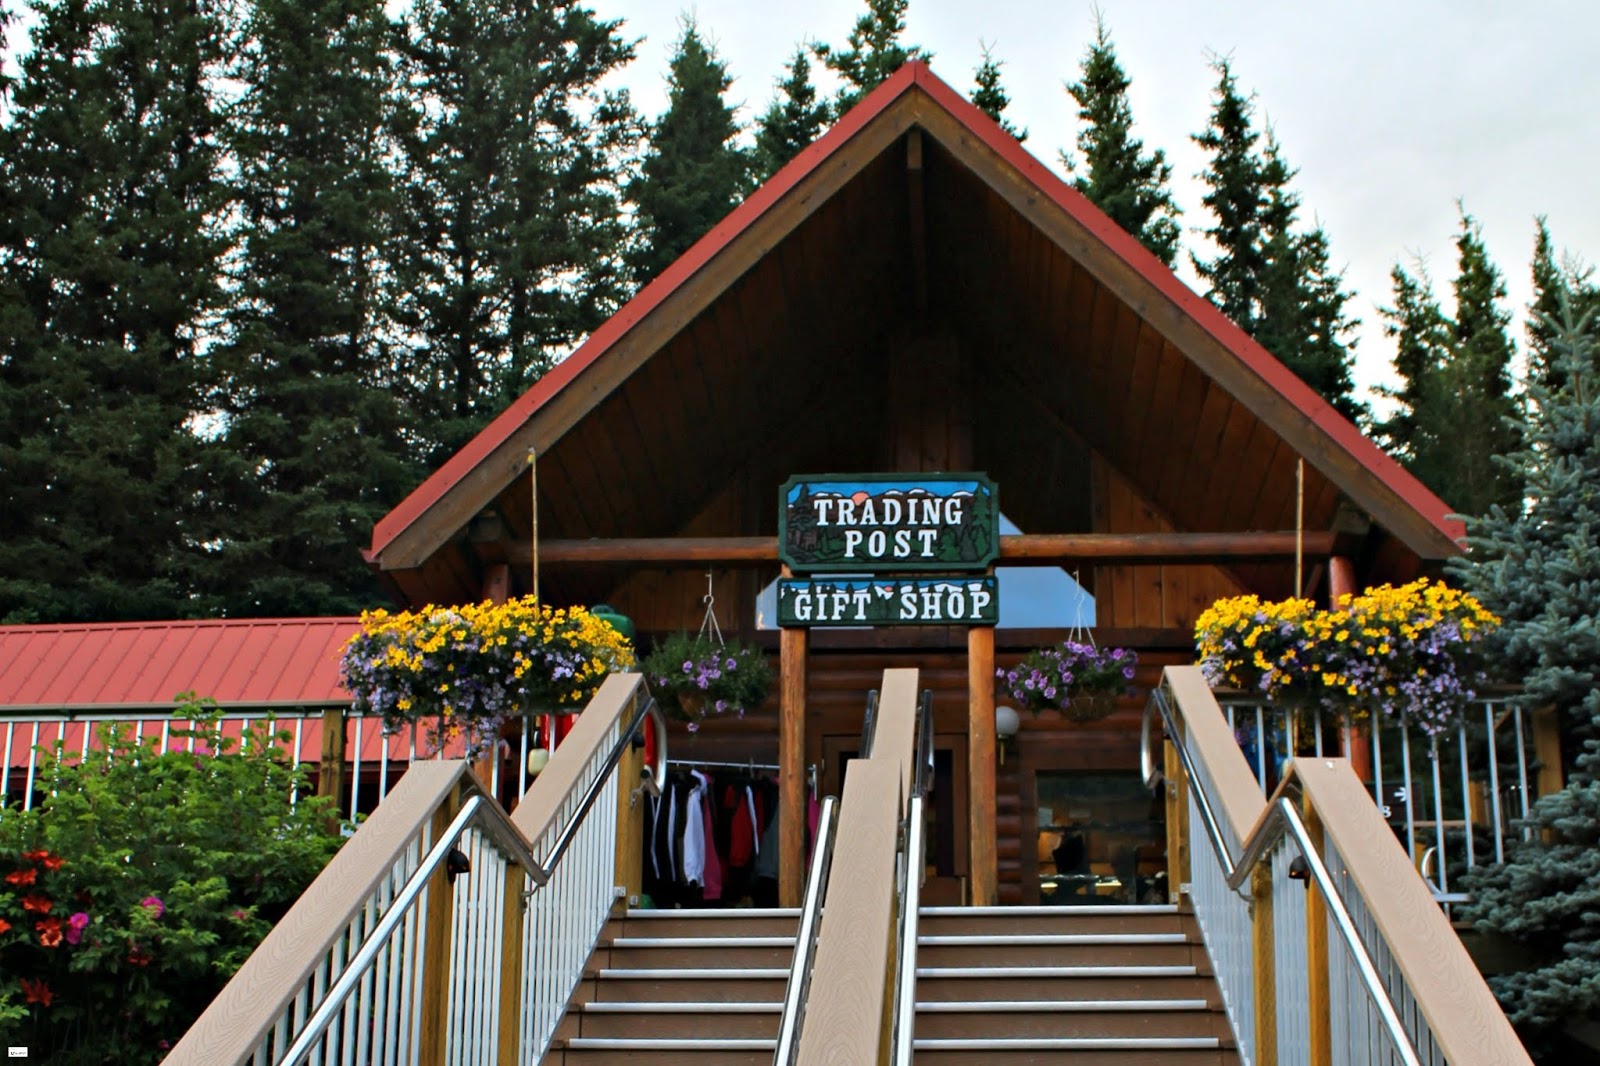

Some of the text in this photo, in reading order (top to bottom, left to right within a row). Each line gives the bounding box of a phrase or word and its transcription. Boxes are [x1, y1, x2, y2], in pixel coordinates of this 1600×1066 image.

[813, 498, 963, 526] TRADING
[844, 529, 937, 557] POST
[794, 591, 990, 621] GIFT SHOP
